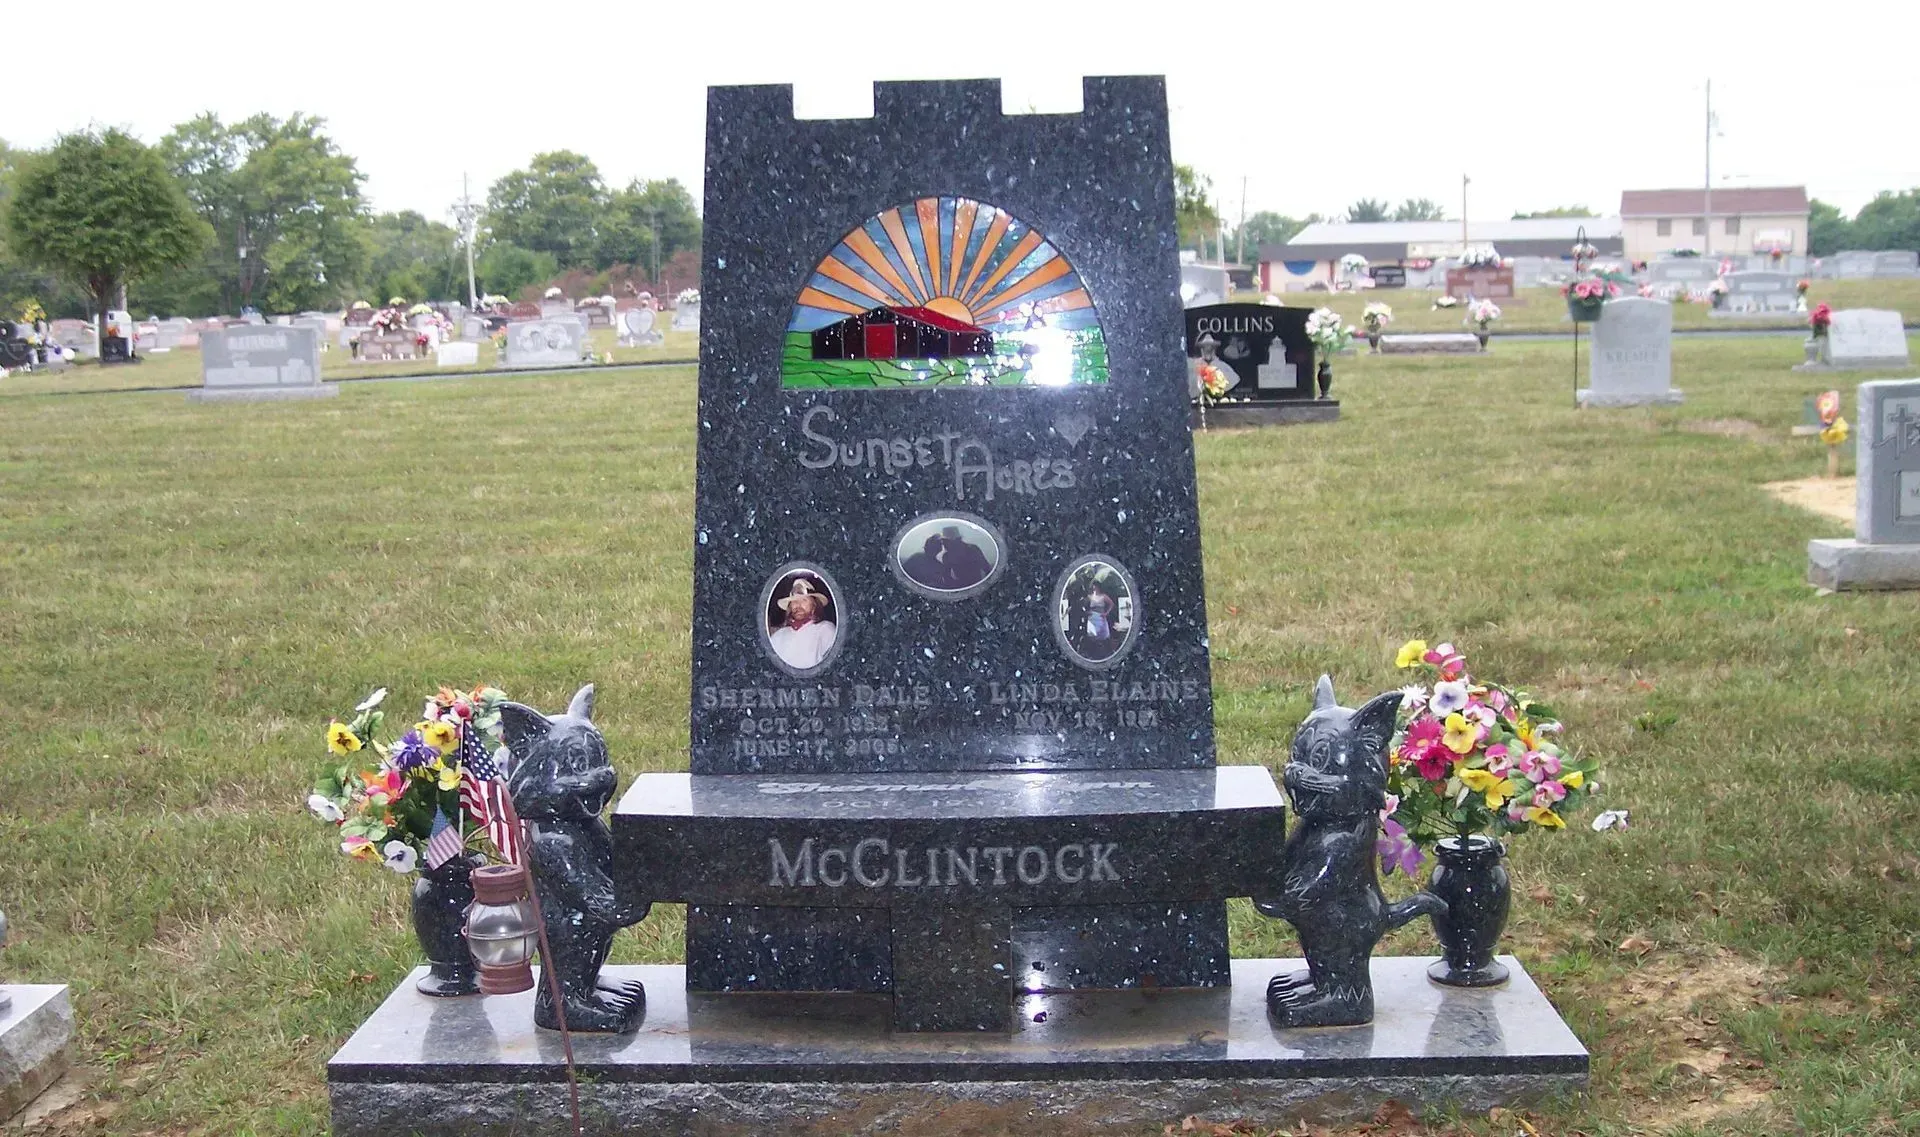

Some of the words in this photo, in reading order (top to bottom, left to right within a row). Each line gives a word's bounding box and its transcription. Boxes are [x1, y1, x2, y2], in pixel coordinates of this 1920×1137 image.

[1197, 316, 1274, 333] COLLINS
[854, 684, 931, 708] DALE
[989, 681, 1078, 704] LINDA
[1091, 680, 1200, 701] ELAINE
[739, 717, 789, 734] OCT
[1014, 710, 1063, 730] NOV
[733, 738, 791, 760] JUNE
[768, 838, 1122, 887] McCLINTOCK
